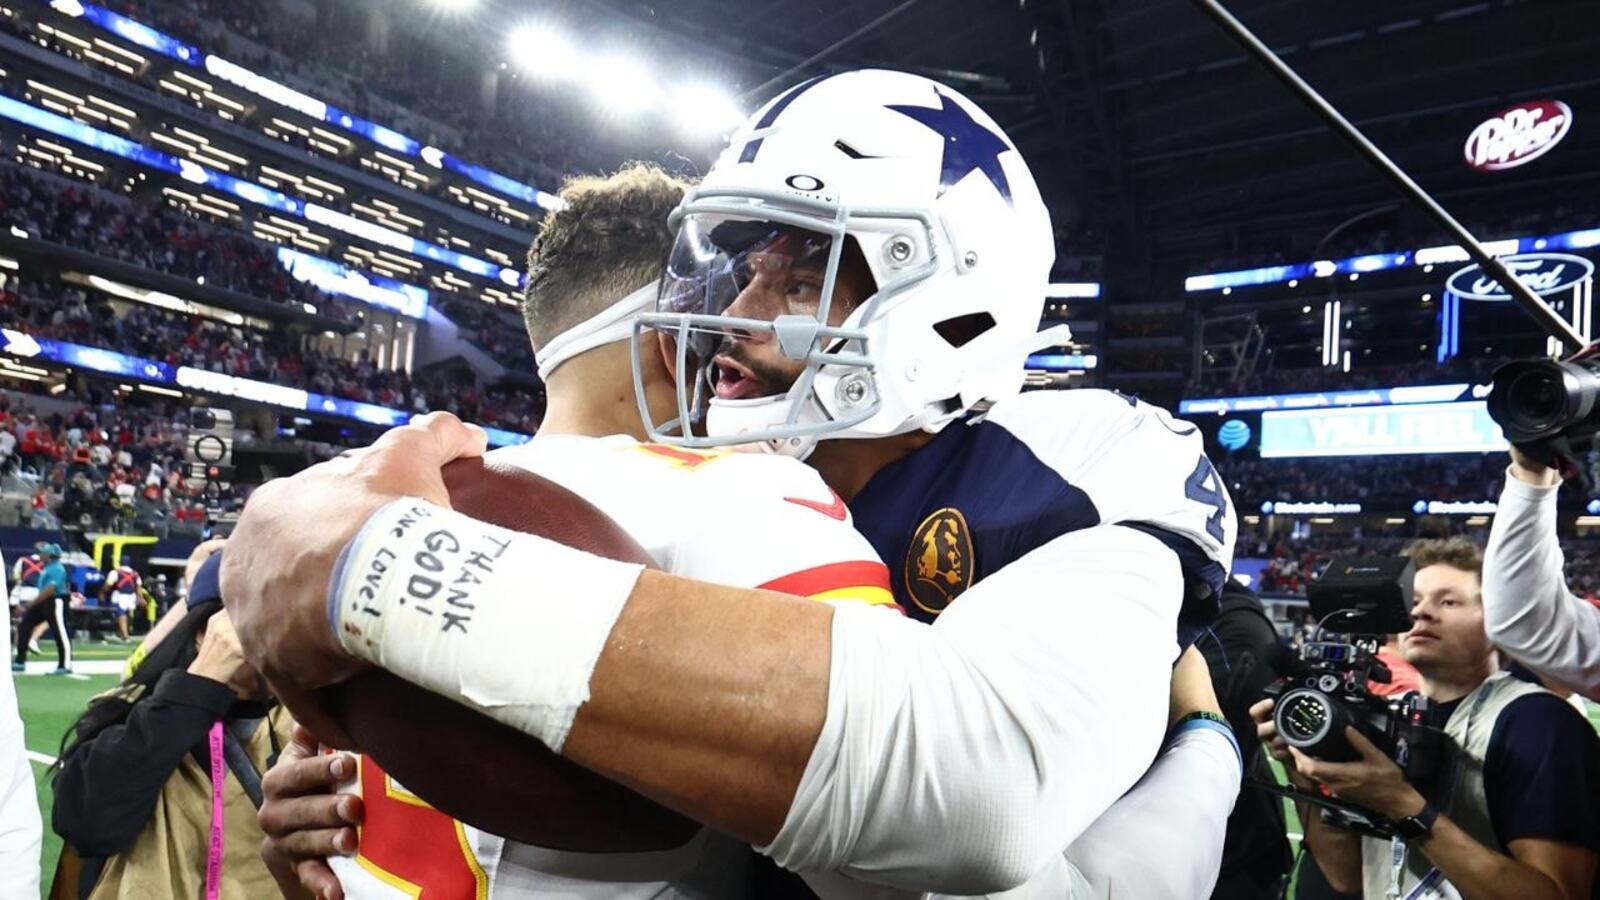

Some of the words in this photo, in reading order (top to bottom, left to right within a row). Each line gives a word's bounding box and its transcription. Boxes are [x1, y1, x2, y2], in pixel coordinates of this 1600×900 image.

[1471, 259, 1566, 295] Frd
[1184, 453, 1226, 546] 4
[399, 529, 460, 615] GOD!
[441, 534, 512, 633] THANK
